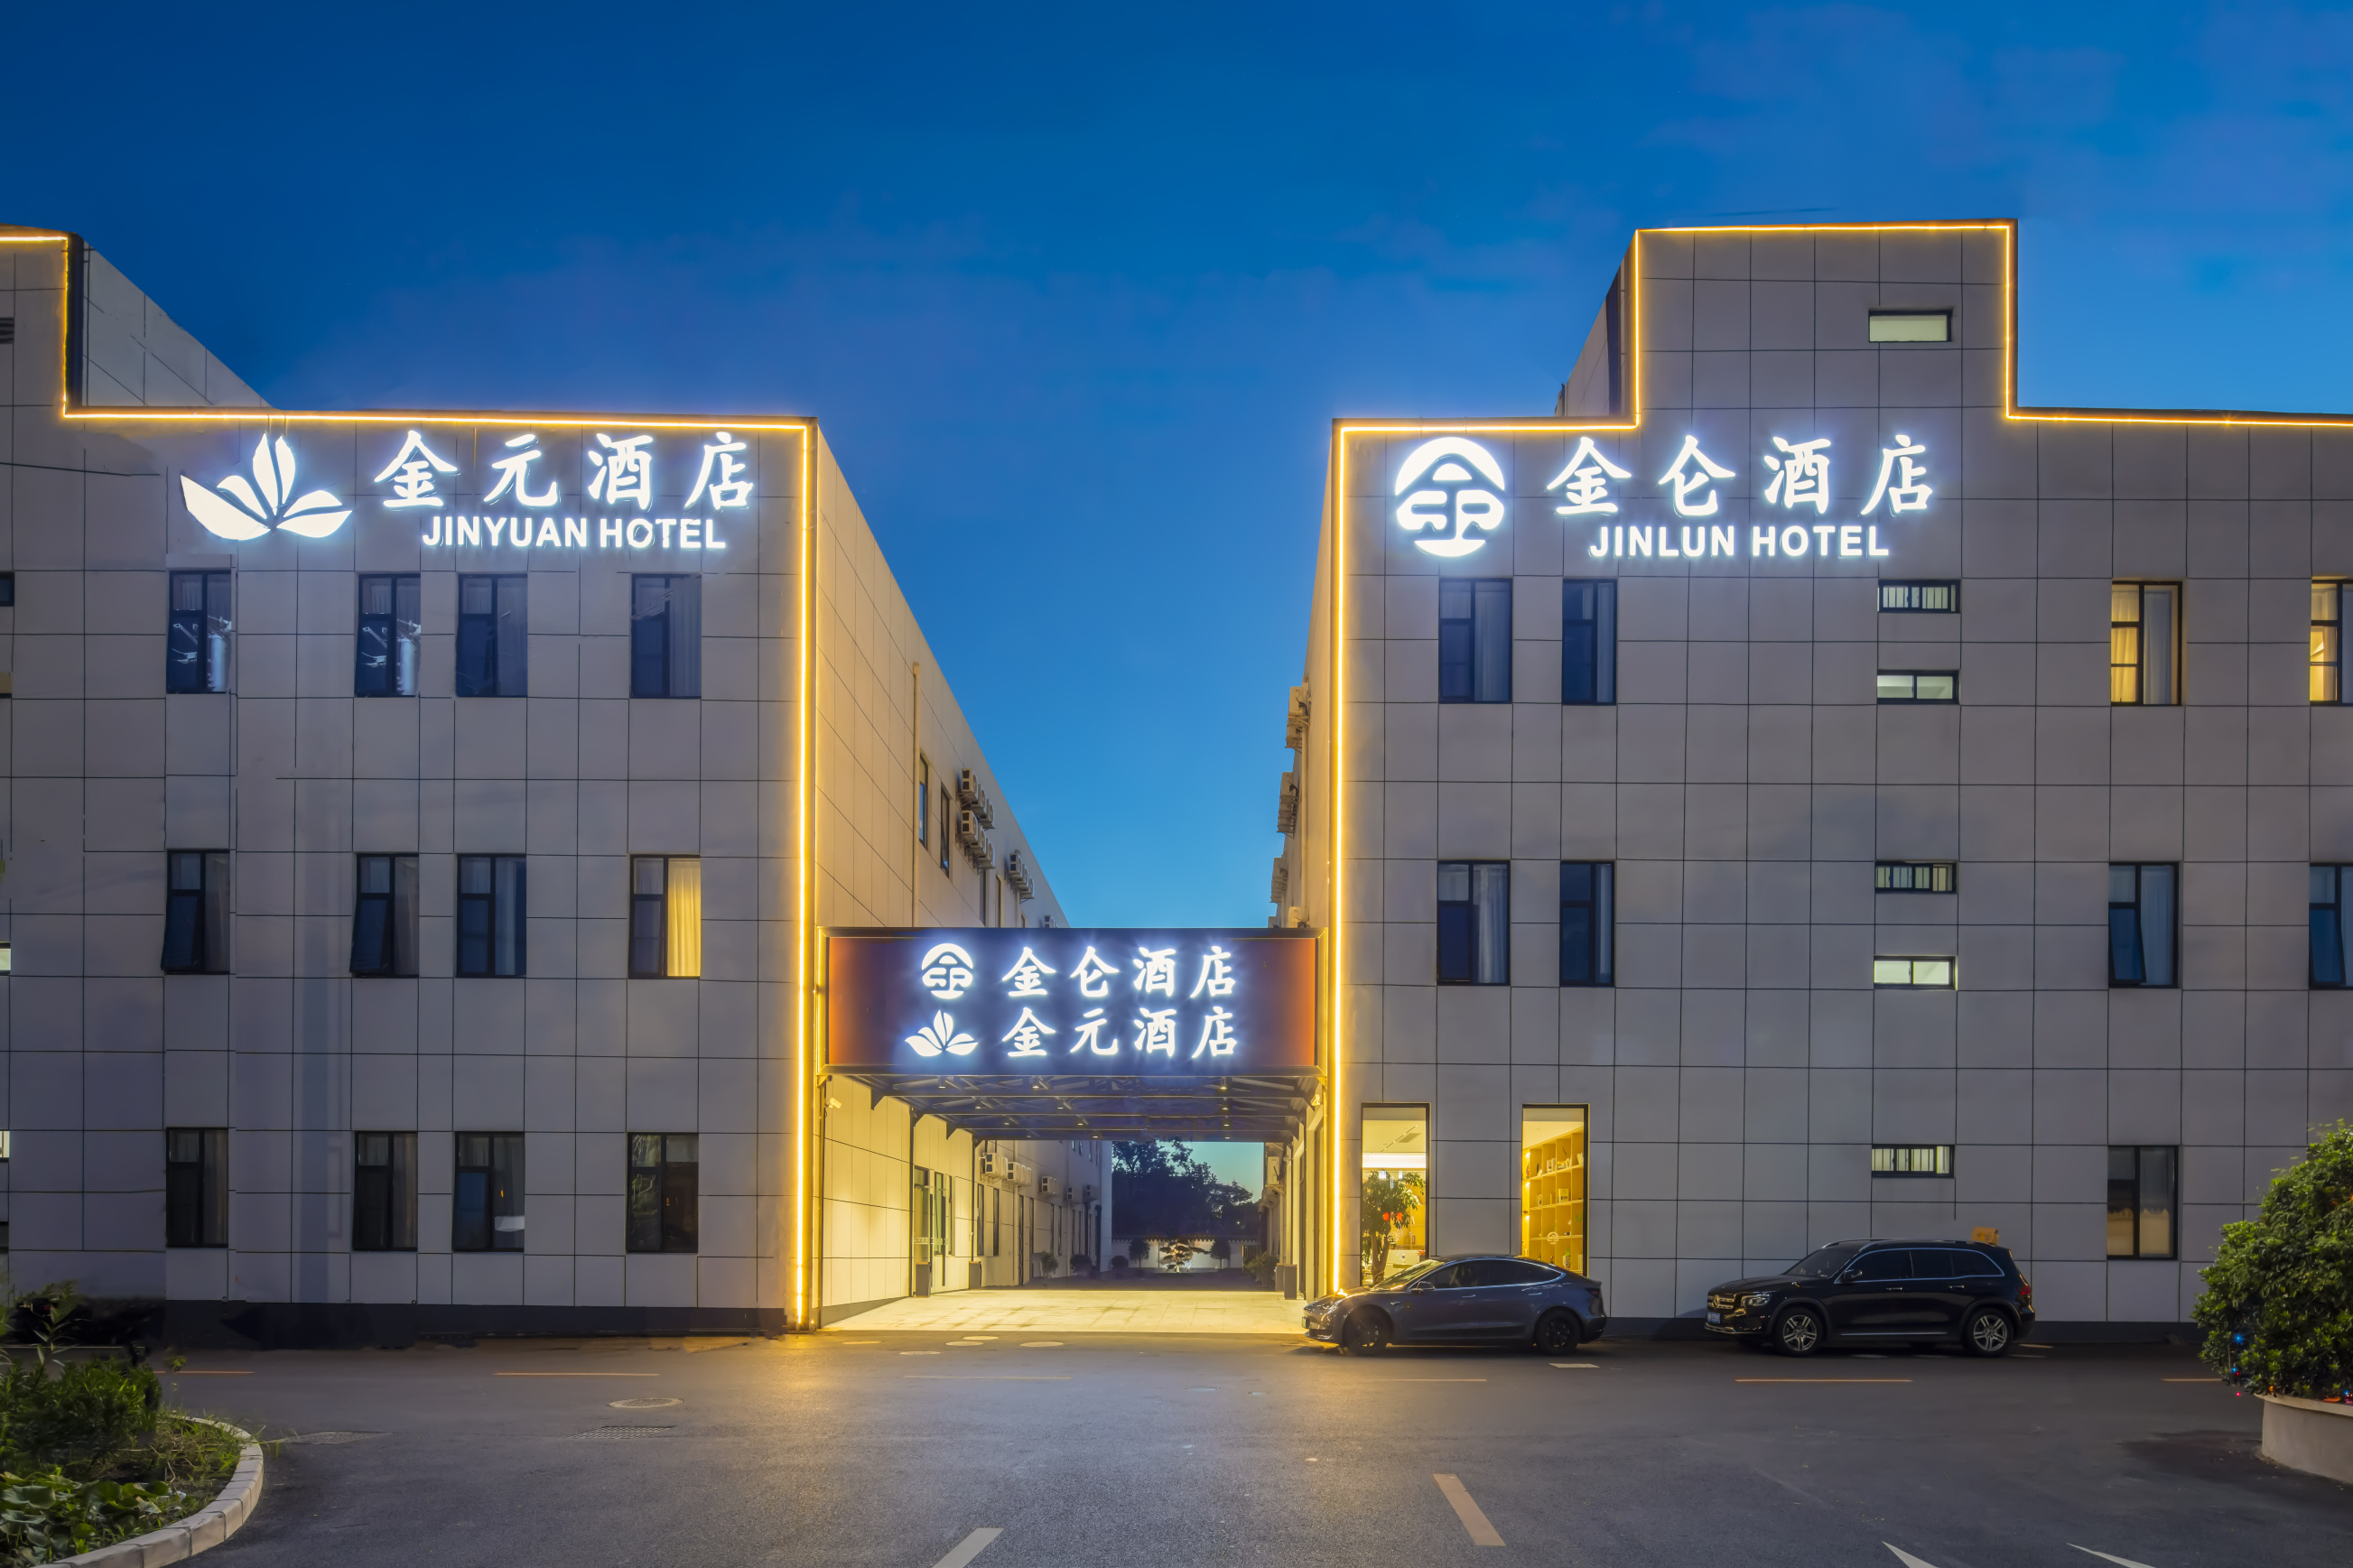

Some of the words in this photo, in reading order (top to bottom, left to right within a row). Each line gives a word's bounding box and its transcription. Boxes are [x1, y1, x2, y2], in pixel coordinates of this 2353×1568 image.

[374, 430, 754, 510] 金元酒店
[1546, 434, 1933, 516] 金仑酒店
[422, 515, 588, 548] JINYUAN
[600, 517, 726, 550] HOTEL
[1589, 524, 1735, 558] JINLUN
[1752, 524, 1889, 558] HOTEL
[1001, 945, 1236, 998] 金仑酒店
[1001, 1006, 1238, 1059] 金元酒店
